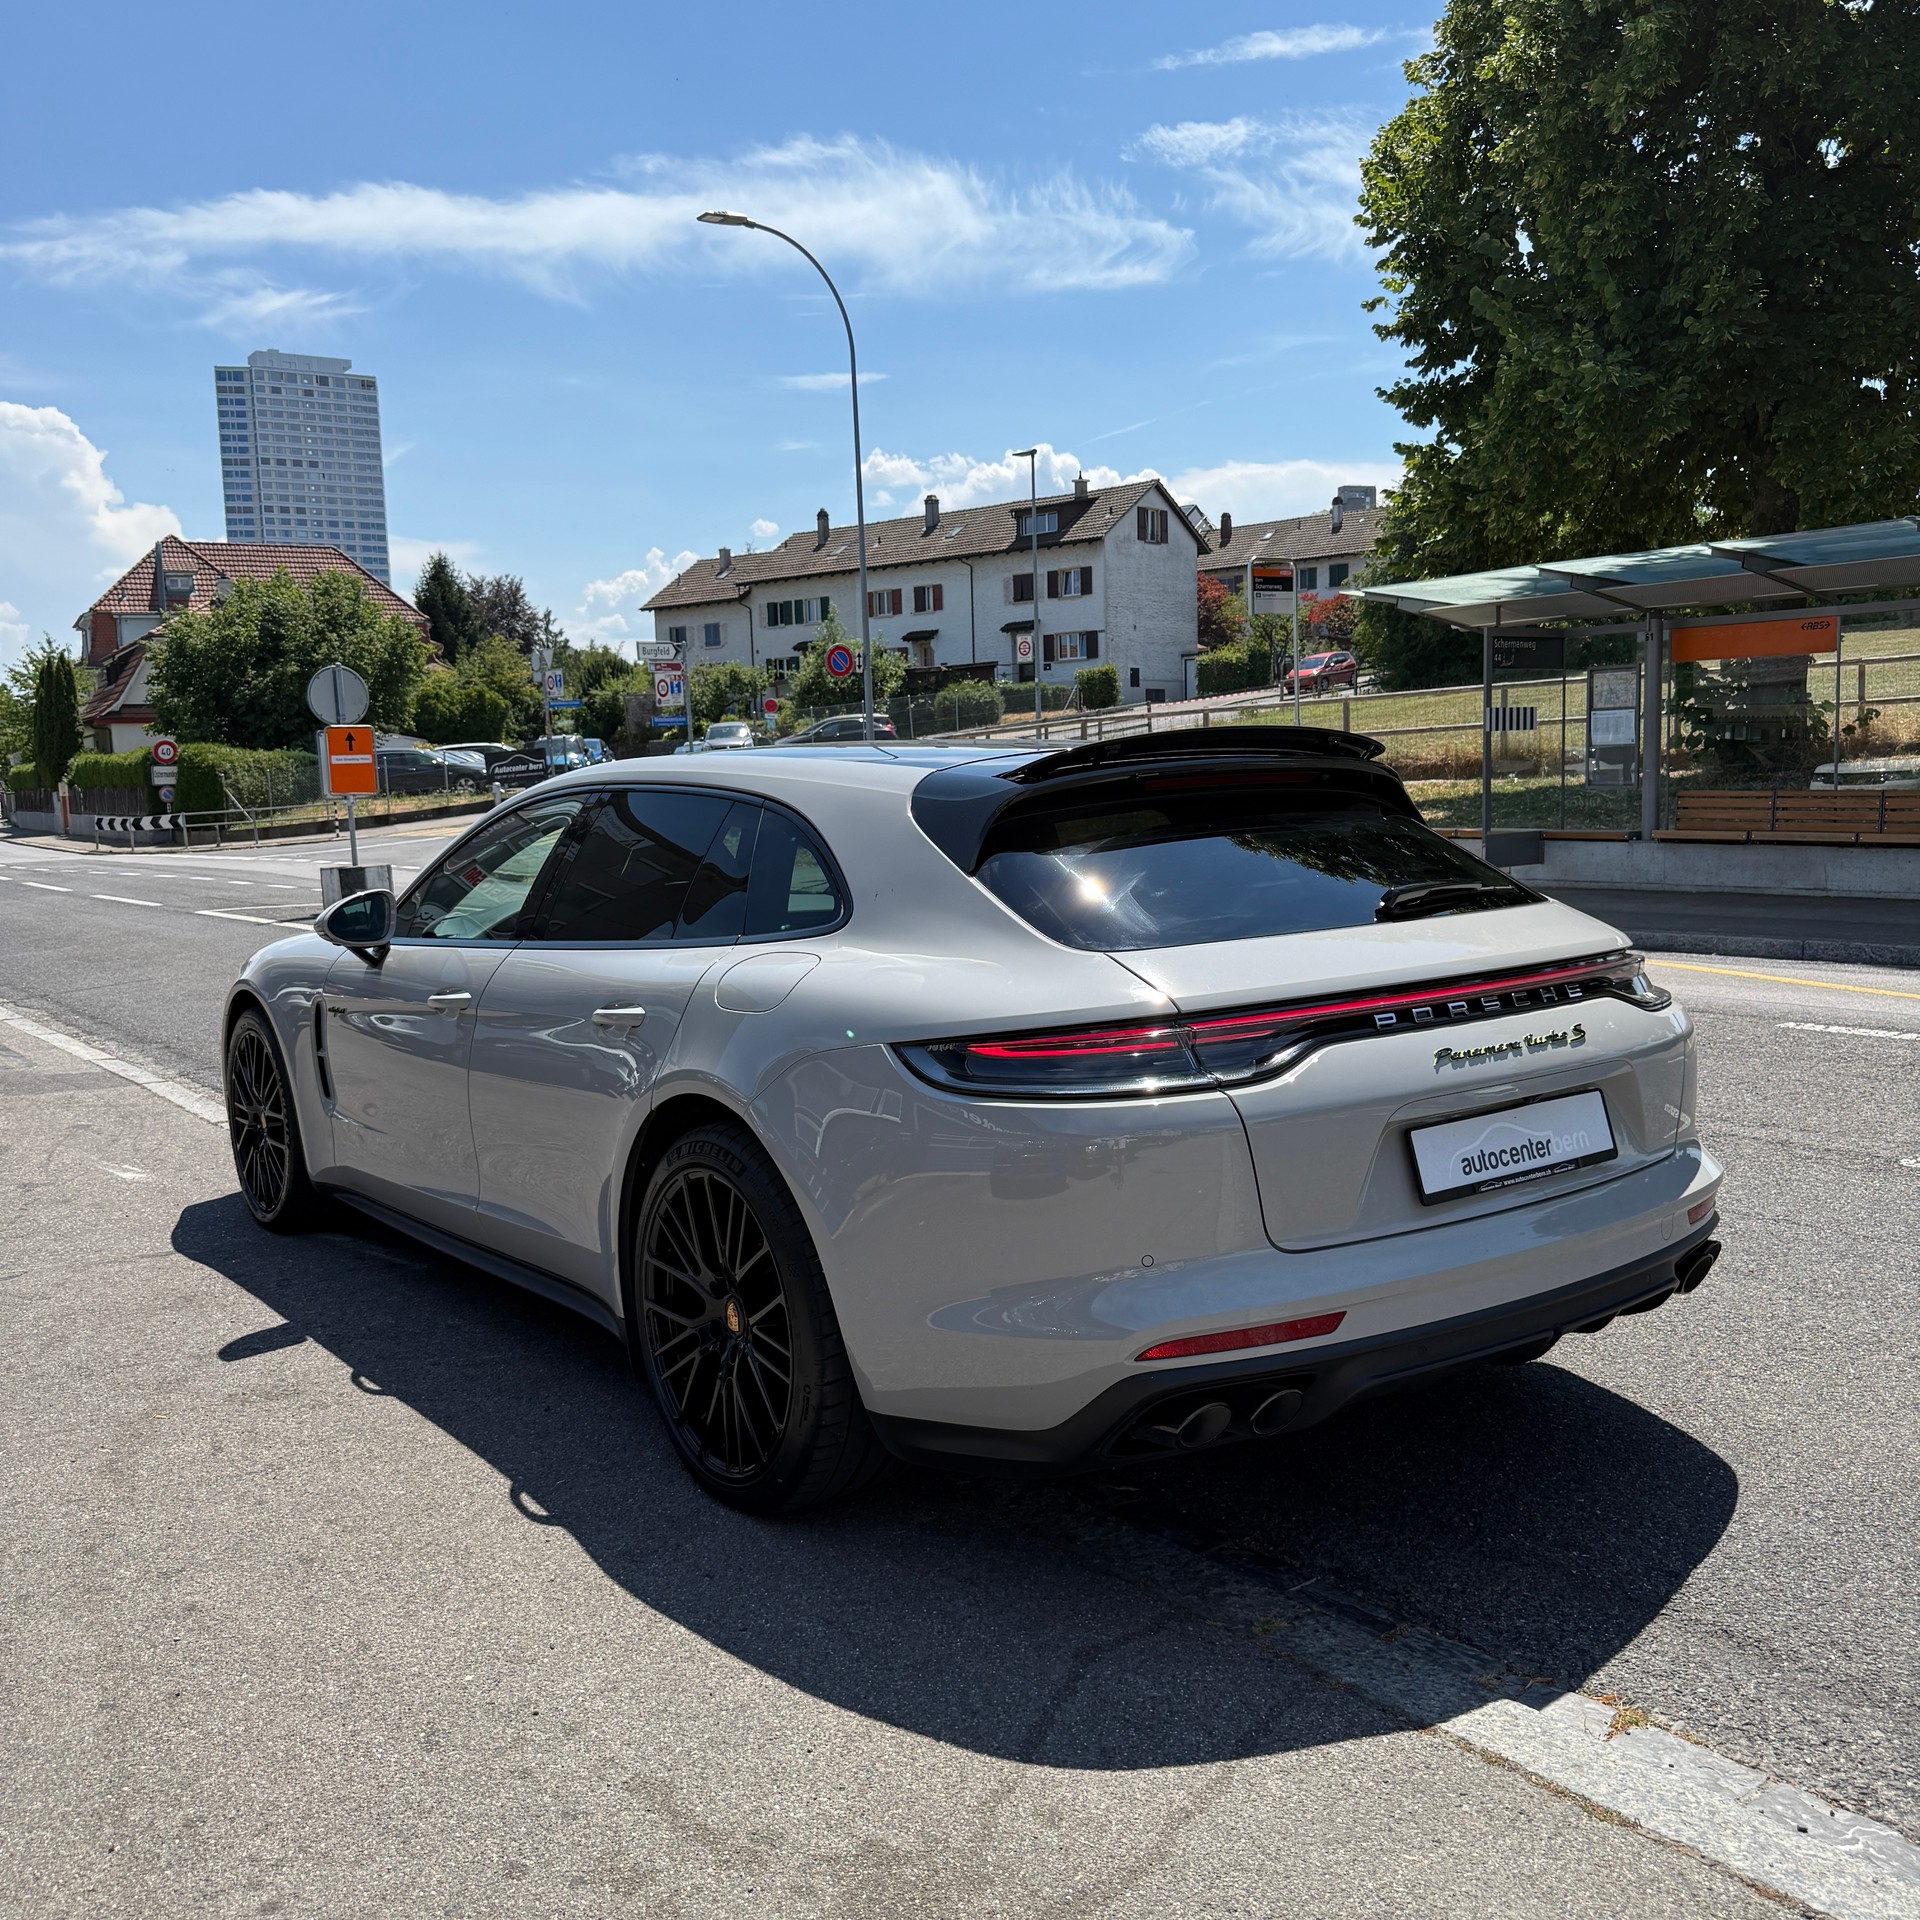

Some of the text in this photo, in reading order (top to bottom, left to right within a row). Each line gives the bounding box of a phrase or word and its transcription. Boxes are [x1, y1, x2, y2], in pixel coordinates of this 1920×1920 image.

[1494, 638, 1536, 650] Schermenweg
[642, 646, 670, 657] Burgfeld
[161, 748, 171, 756] 40
[494, 763, 543, 774] Autocenter Bern
[1374, 984, 1583, 1030] PORSCHE
[1432, 1040, 1522, 1067] Panamera
[1568, 1023, 1586, 1044] S
[680, 1141, 744, 1173] MICHELIN
